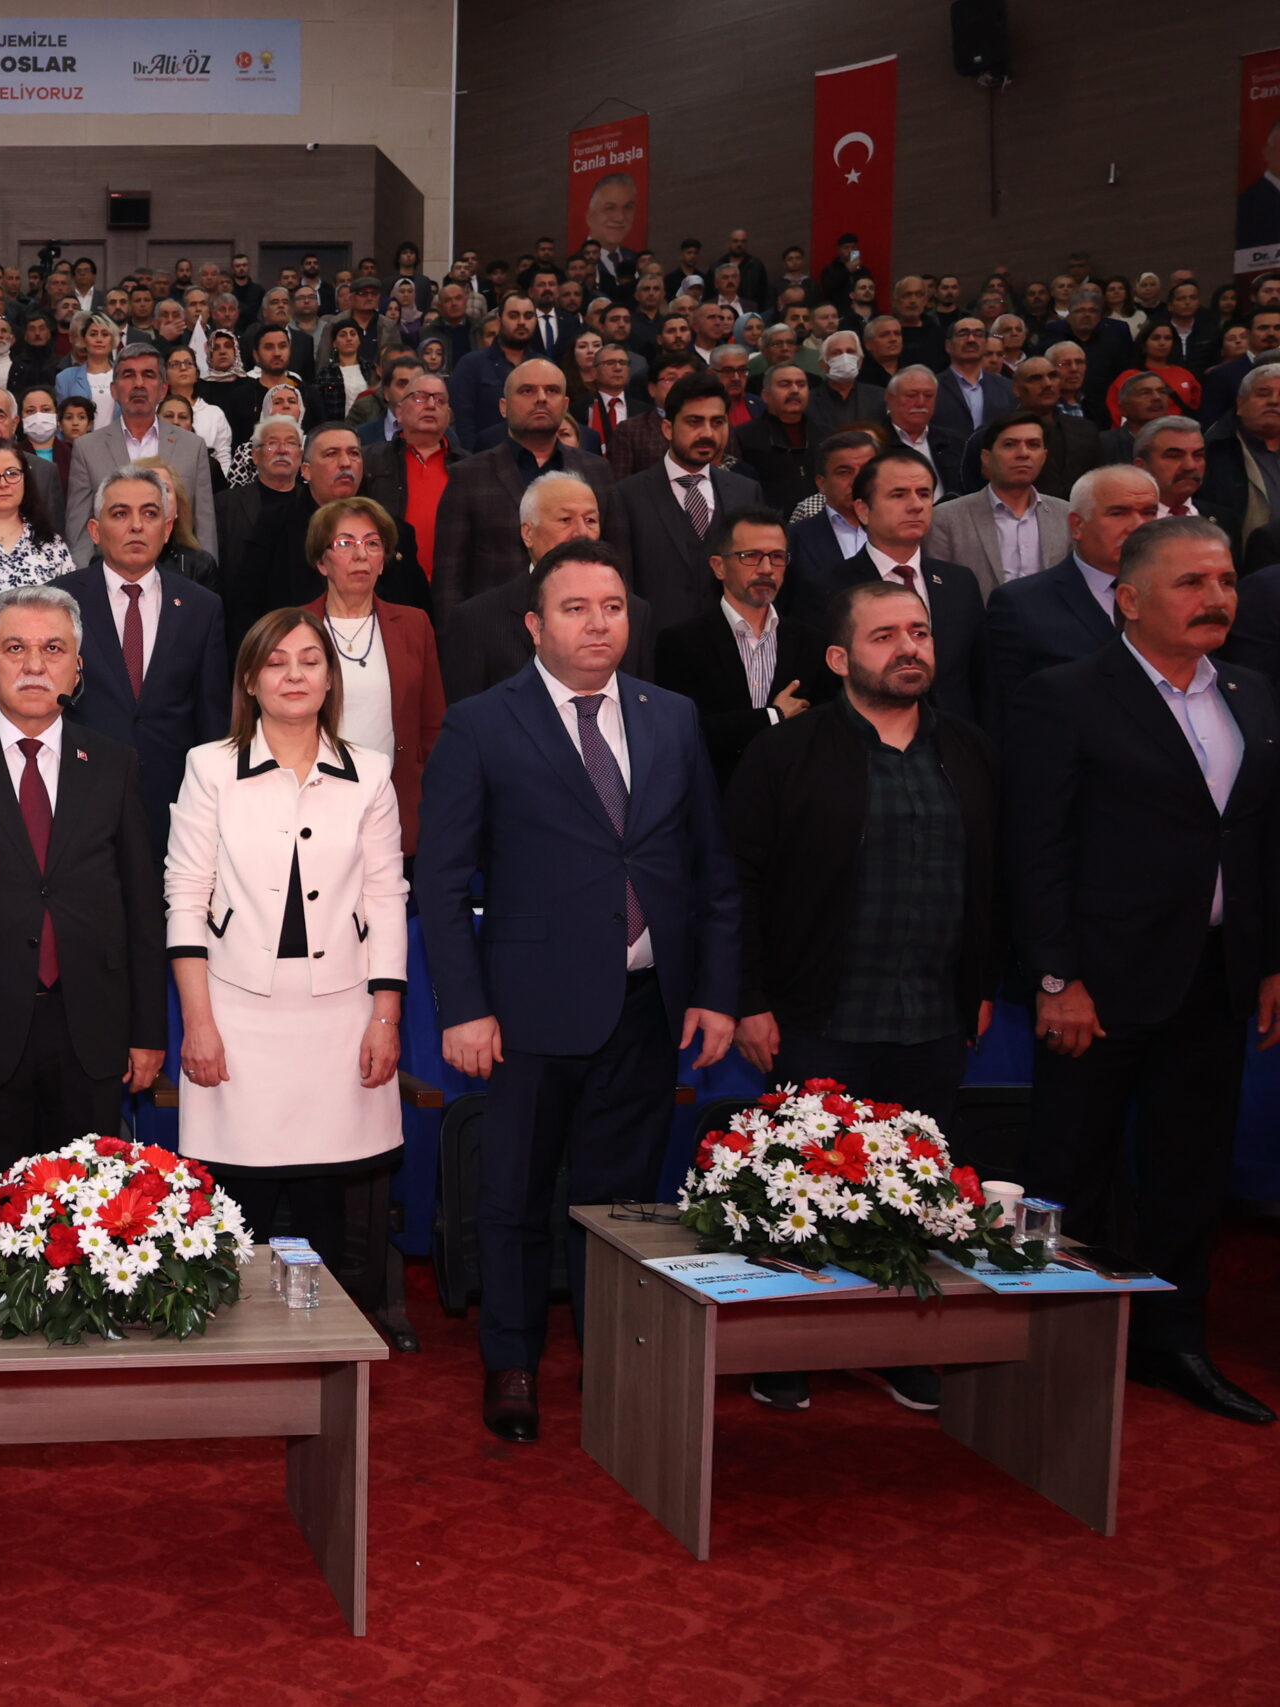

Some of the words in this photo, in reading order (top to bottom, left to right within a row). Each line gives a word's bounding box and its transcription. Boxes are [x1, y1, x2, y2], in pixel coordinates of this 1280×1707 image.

[1249, 84, 1280, 100] Can
[573, 153, 605, 173] Canla
[610, 145, 643, 165] başla
